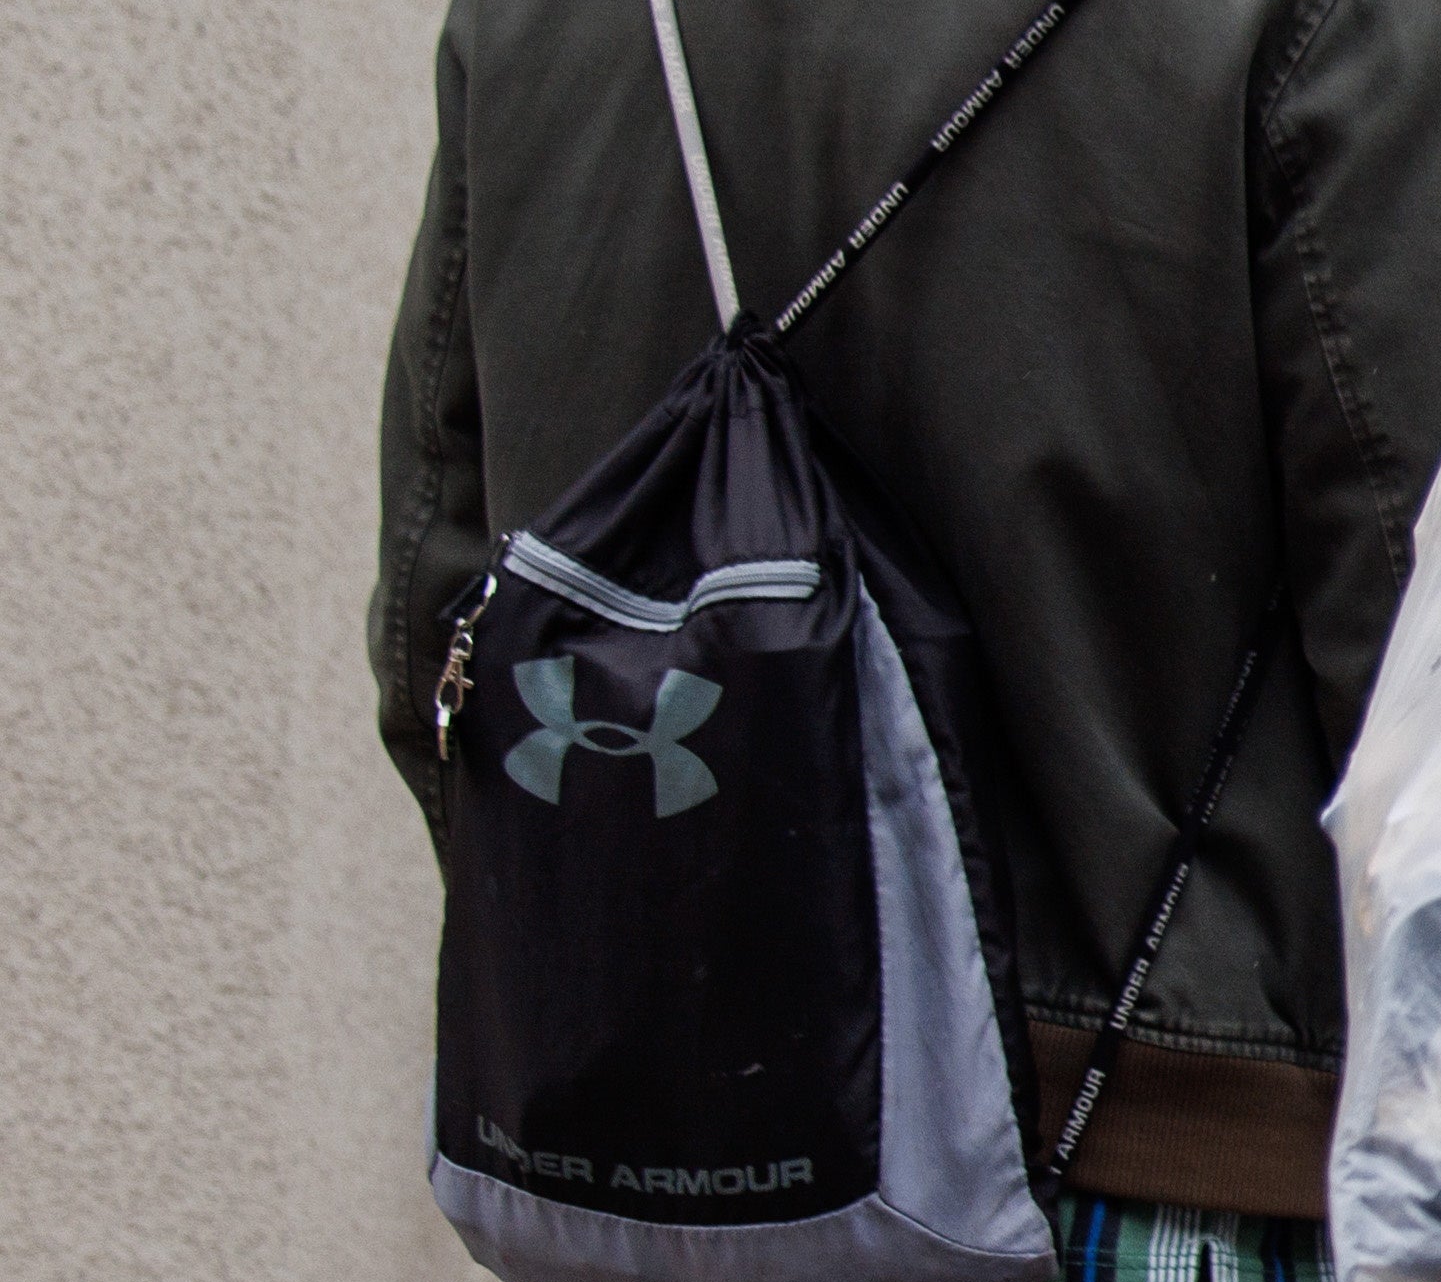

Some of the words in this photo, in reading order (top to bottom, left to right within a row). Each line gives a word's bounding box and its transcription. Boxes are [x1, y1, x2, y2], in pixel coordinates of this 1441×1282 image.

[1002, 1, 1066, 70] UNDER
[930, 68, 1003, 153] ARMOUR
[847, 180, 910, 250] UNDER
[775, 248, 847, 332] ARMOUR
[1108, 957, 1151, 1031] UNDER
[1145, 861, 1190, 951] ARMOUR
[476, 1114, 595, 1185] UNDER
[608, 1155, 815, 1197] ARMOUR
[1054, 1067, 1107, 1161] ARMOUR
